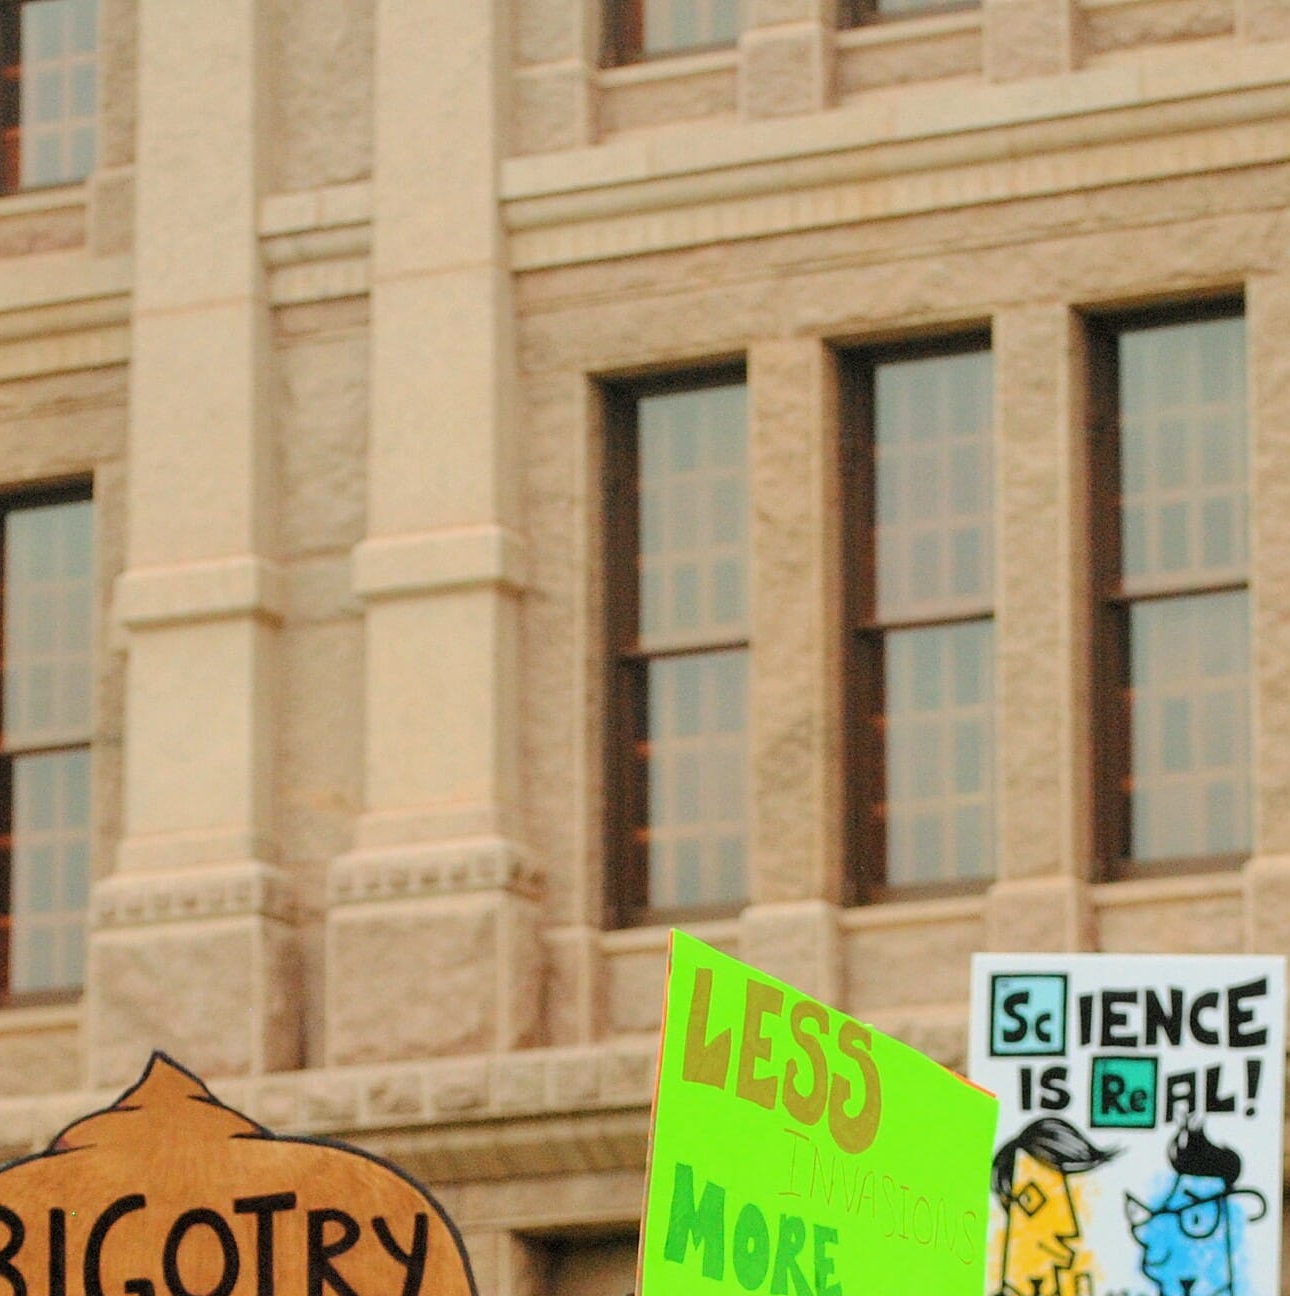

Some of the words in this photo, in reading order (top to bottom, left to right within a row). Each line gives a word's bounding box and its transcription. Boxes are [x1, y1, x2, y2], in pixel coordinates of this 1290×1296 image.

[681, 966, 883, 1155] LESS
[1019, 1066, 1071, 1111] IS
[778, 1127, 977, 1265] INVASIONS
